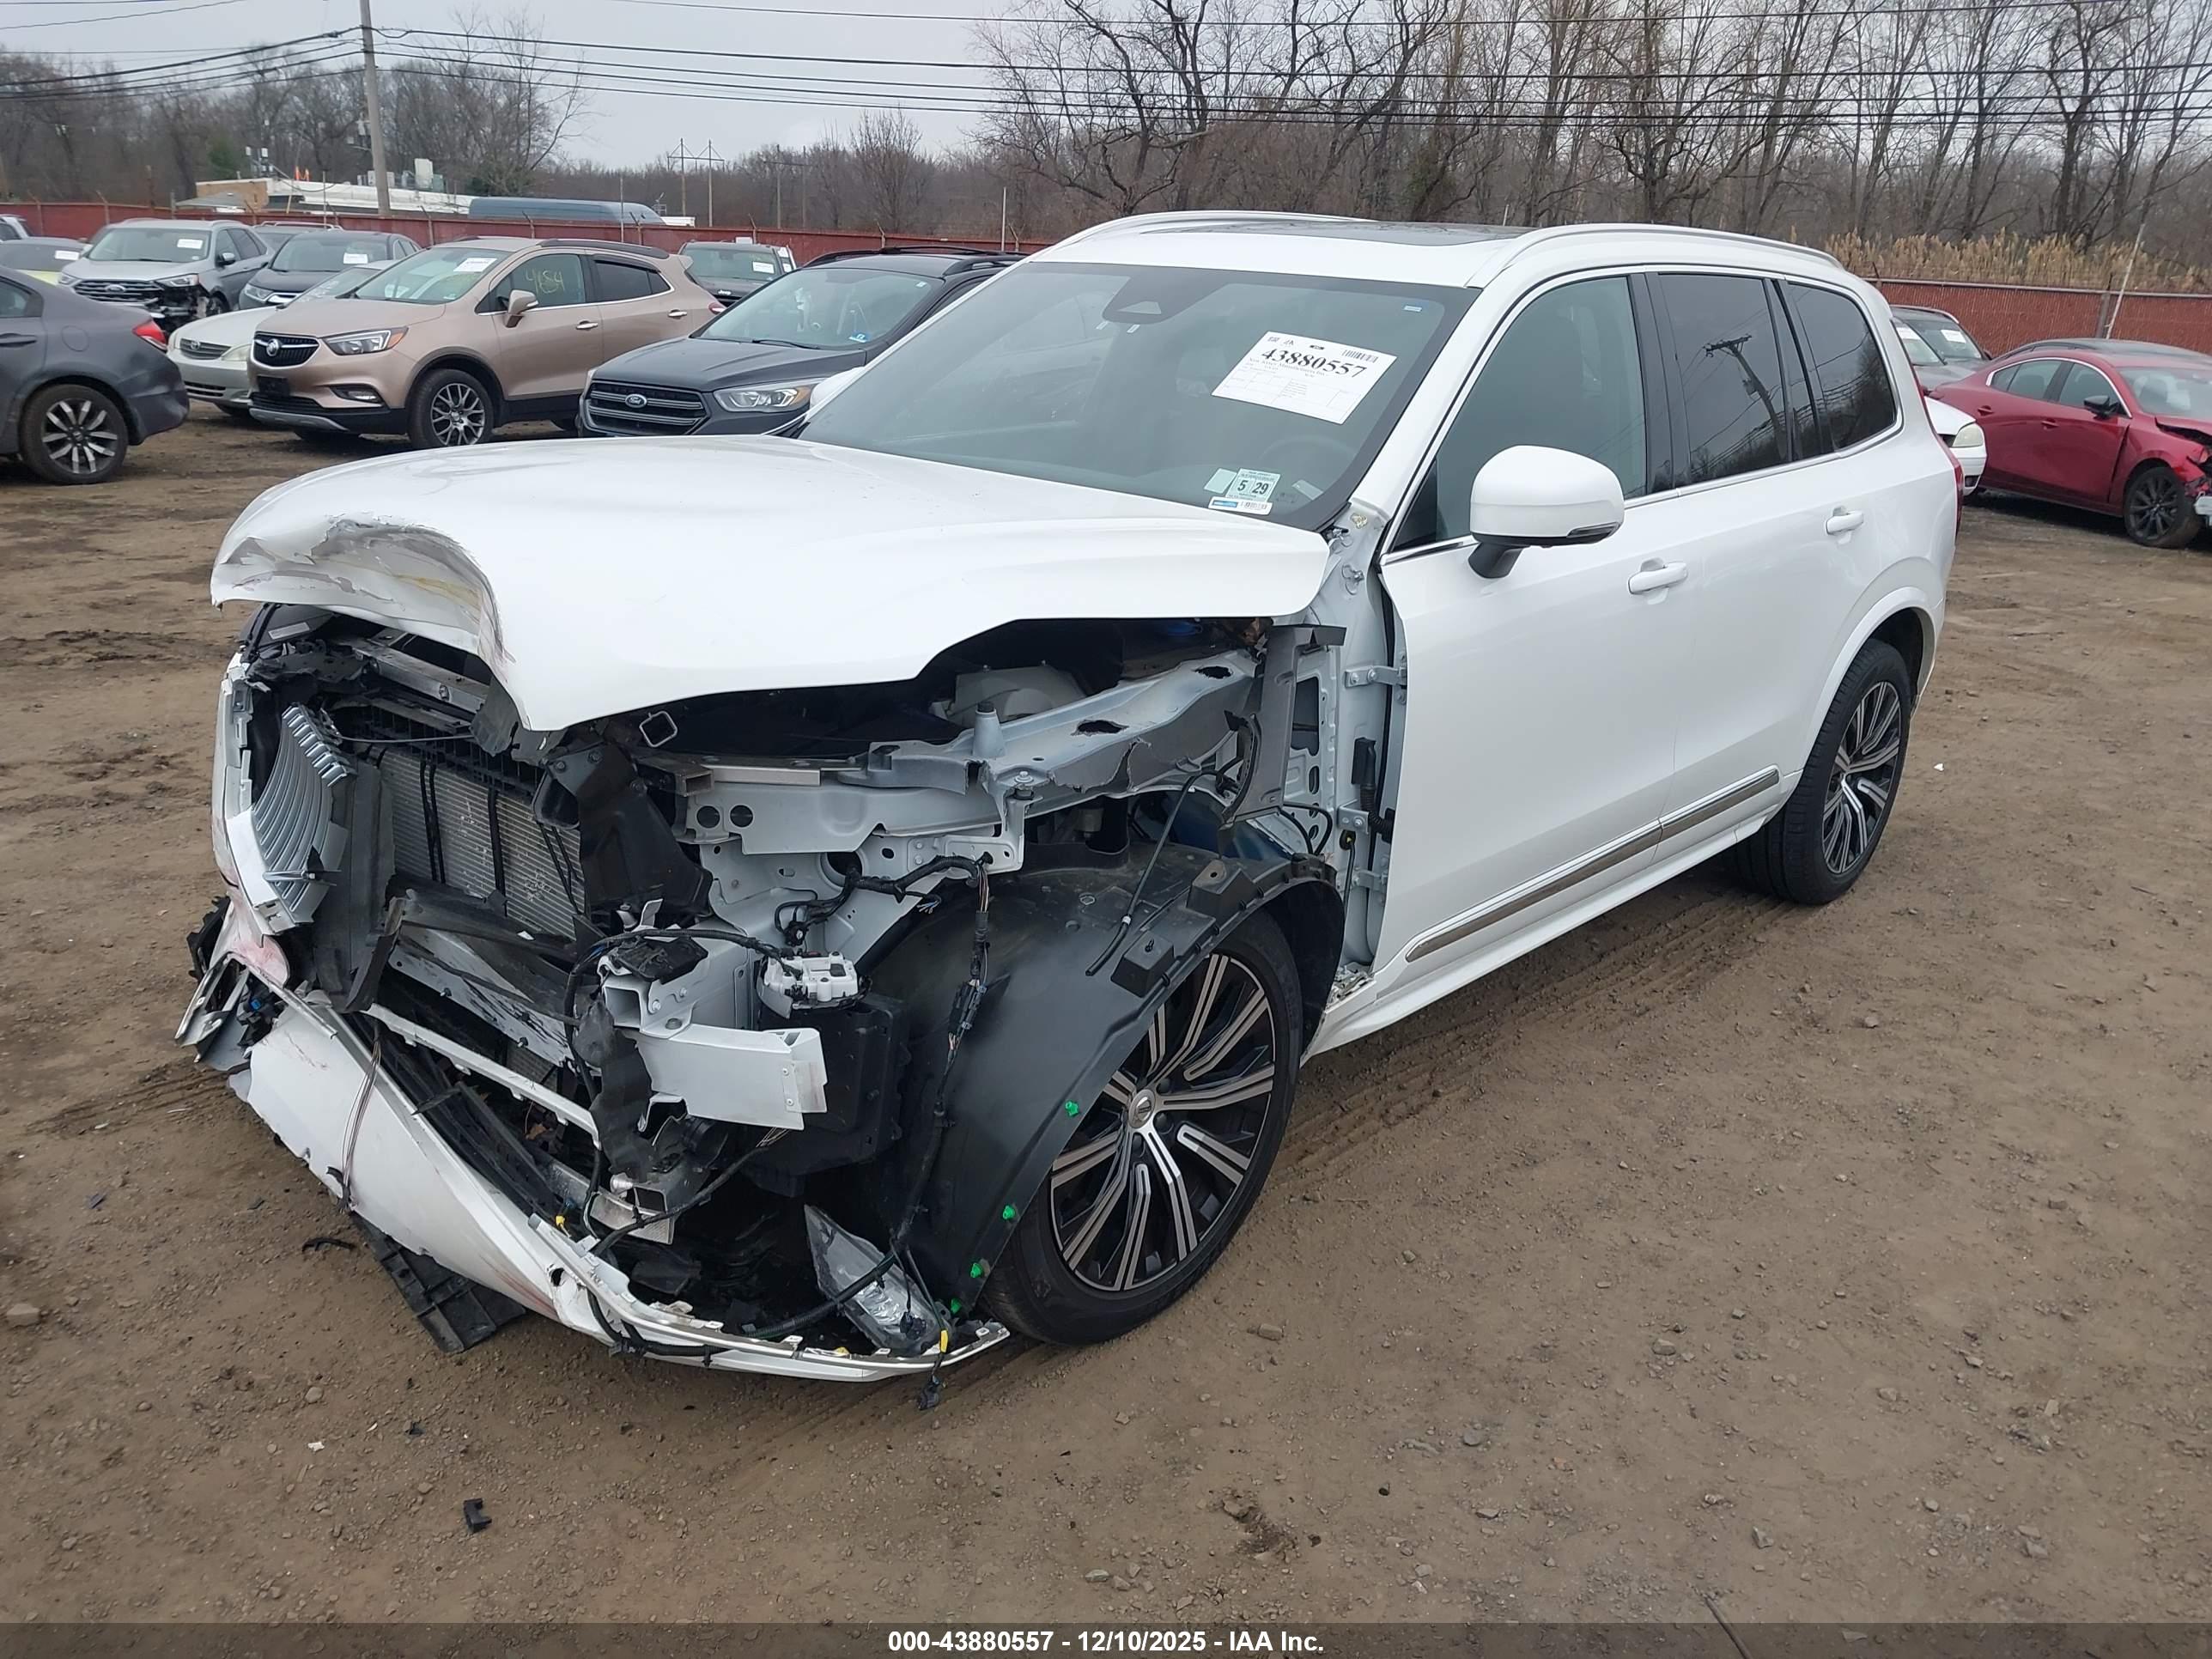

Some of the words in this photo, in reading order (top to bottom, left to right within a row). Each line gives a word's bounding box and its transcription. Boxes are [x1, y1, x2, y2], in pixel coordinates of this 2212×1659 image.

[1261, 348, 1368, 378] 43880557
[1237, 480, 1249, 491] 5
[1252, 482, 1269, 495] 29
